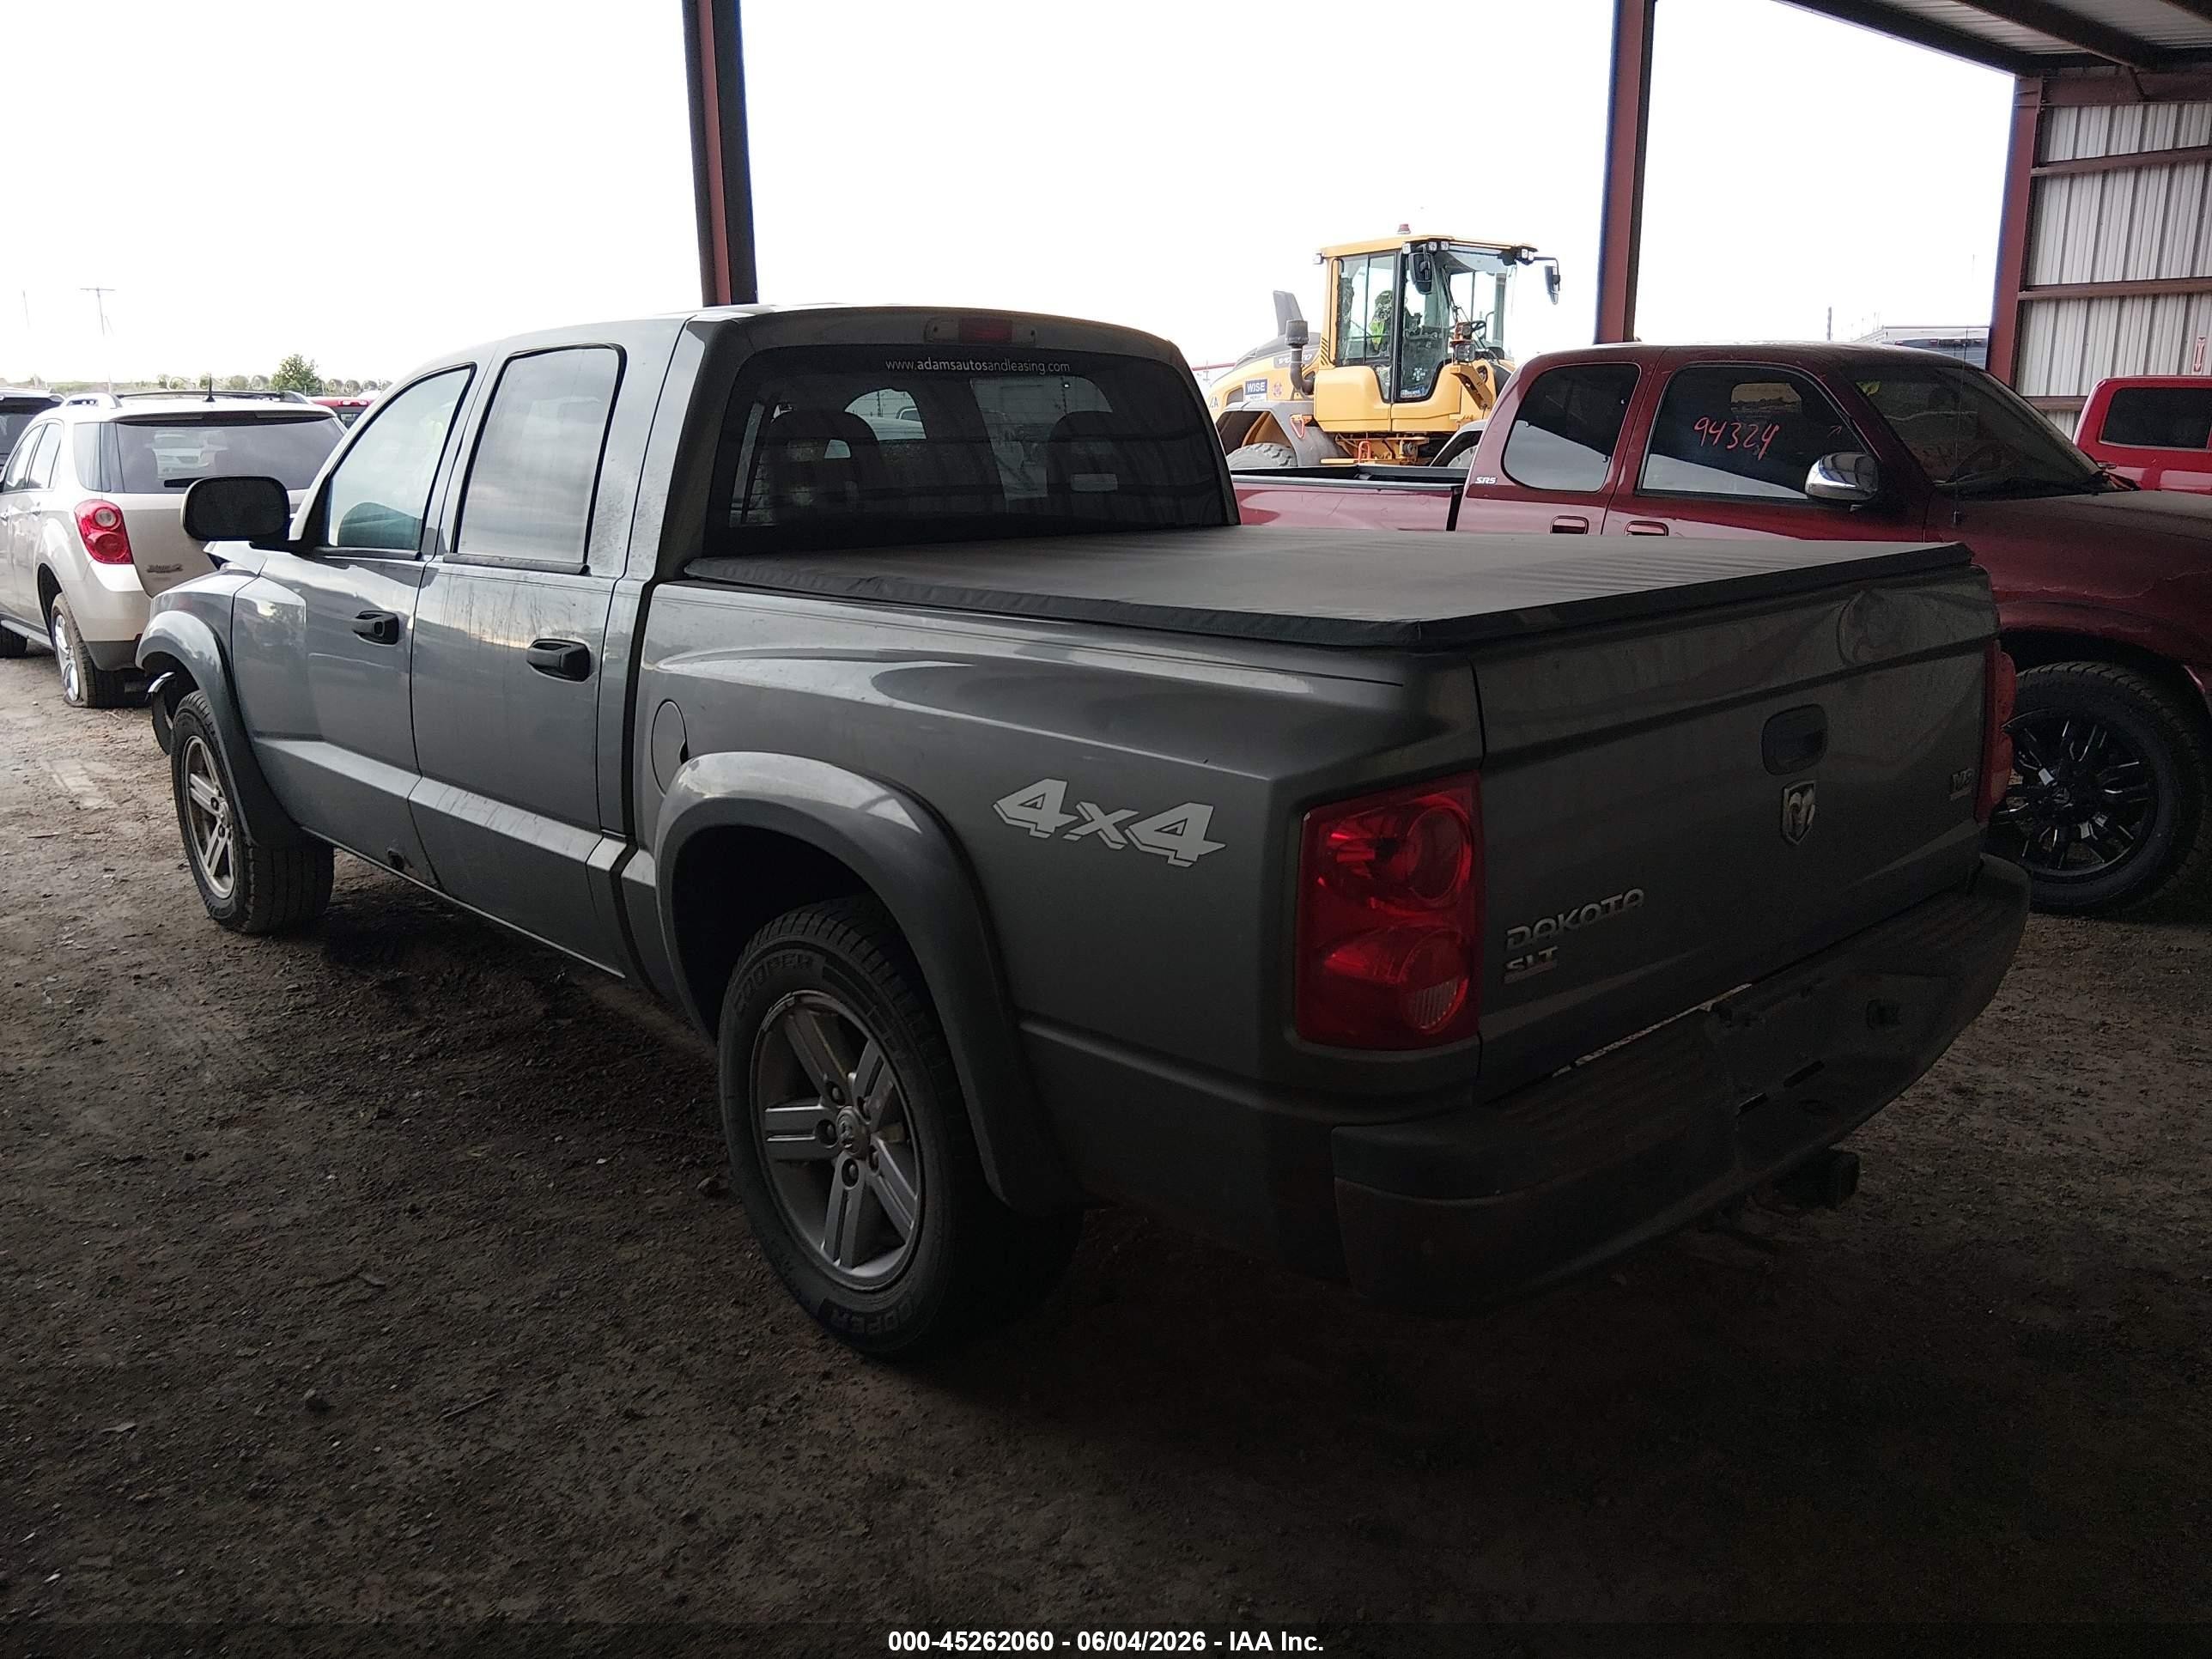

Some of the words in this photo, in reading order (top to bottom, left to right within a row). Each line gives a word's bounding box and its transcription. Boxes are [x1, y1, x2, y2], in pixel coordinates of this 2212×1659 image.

[885, 356, 1071, 375] www.adamsautosandleasing.com
[1246, 380, 1267, 393] WISE
[1505, 887, 1645, 951] DAKOTA
[1504, 945, 1559, 974] SLT
